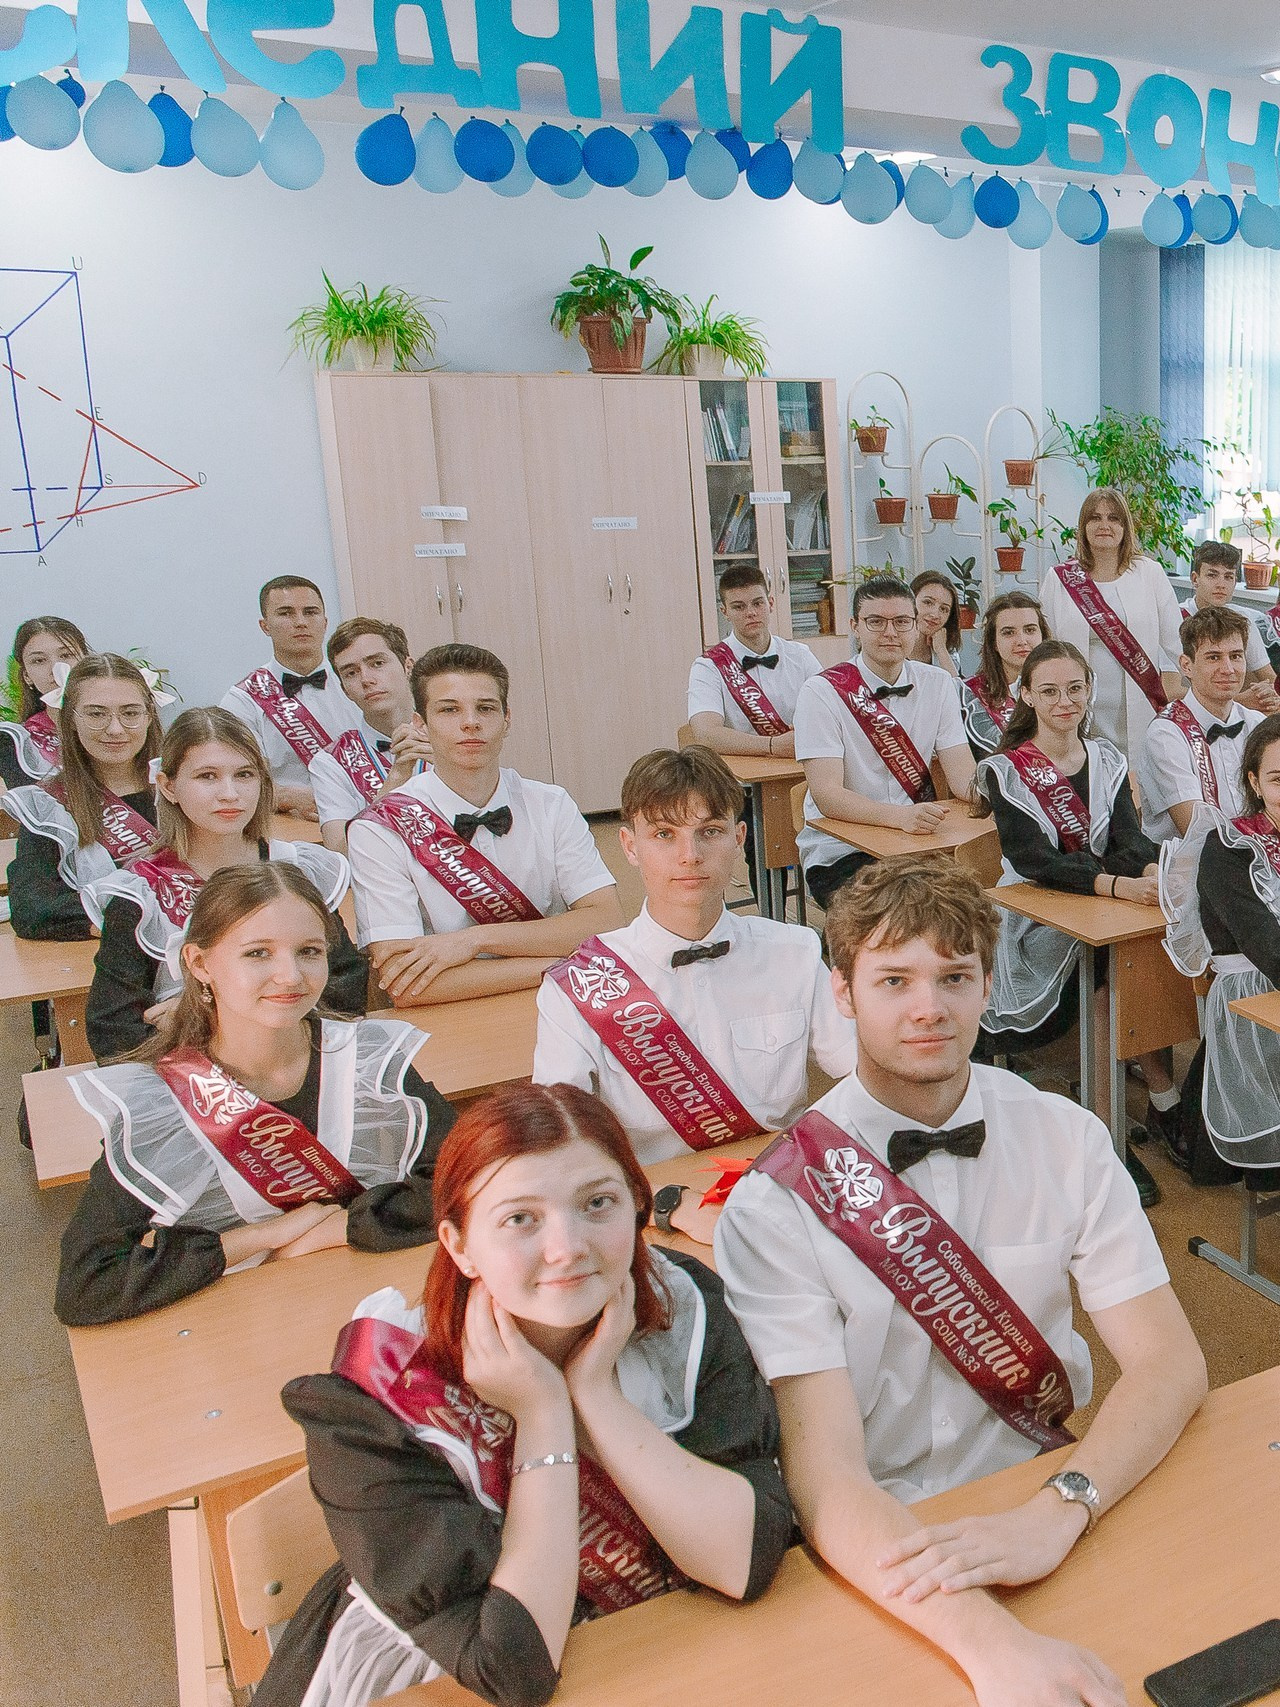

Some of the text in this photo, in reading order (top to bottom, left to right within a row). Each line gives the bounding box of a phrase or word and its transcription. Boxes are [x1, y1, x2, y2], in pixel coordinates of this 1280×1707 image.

[71, 255, 84, 271] U
[94, 406, 105, 421] E
[104, 473, 113, 485] S
[197, 471, 208, 486] D
[434, 865, 459, 886] МАОУ
[615, 1038, 643, 1067] МАОУ
[664, 1033, 700, 1076] Середюк
[612, 1001, 735, 1144] Выпускник
[655, 1088, 677, 1115] СОШ
[236, 1149, 269, 1178] МАОУ
[879, 1256, 917, 1293] МАОУ
[870, 1202, 1030, 1391] Выпускник
[936, 1239, 999, 1314] Соболевский
[994, 1306, 1035, 1357] Кирилл
[932, 1317, 981, 1373] СОШ №33
